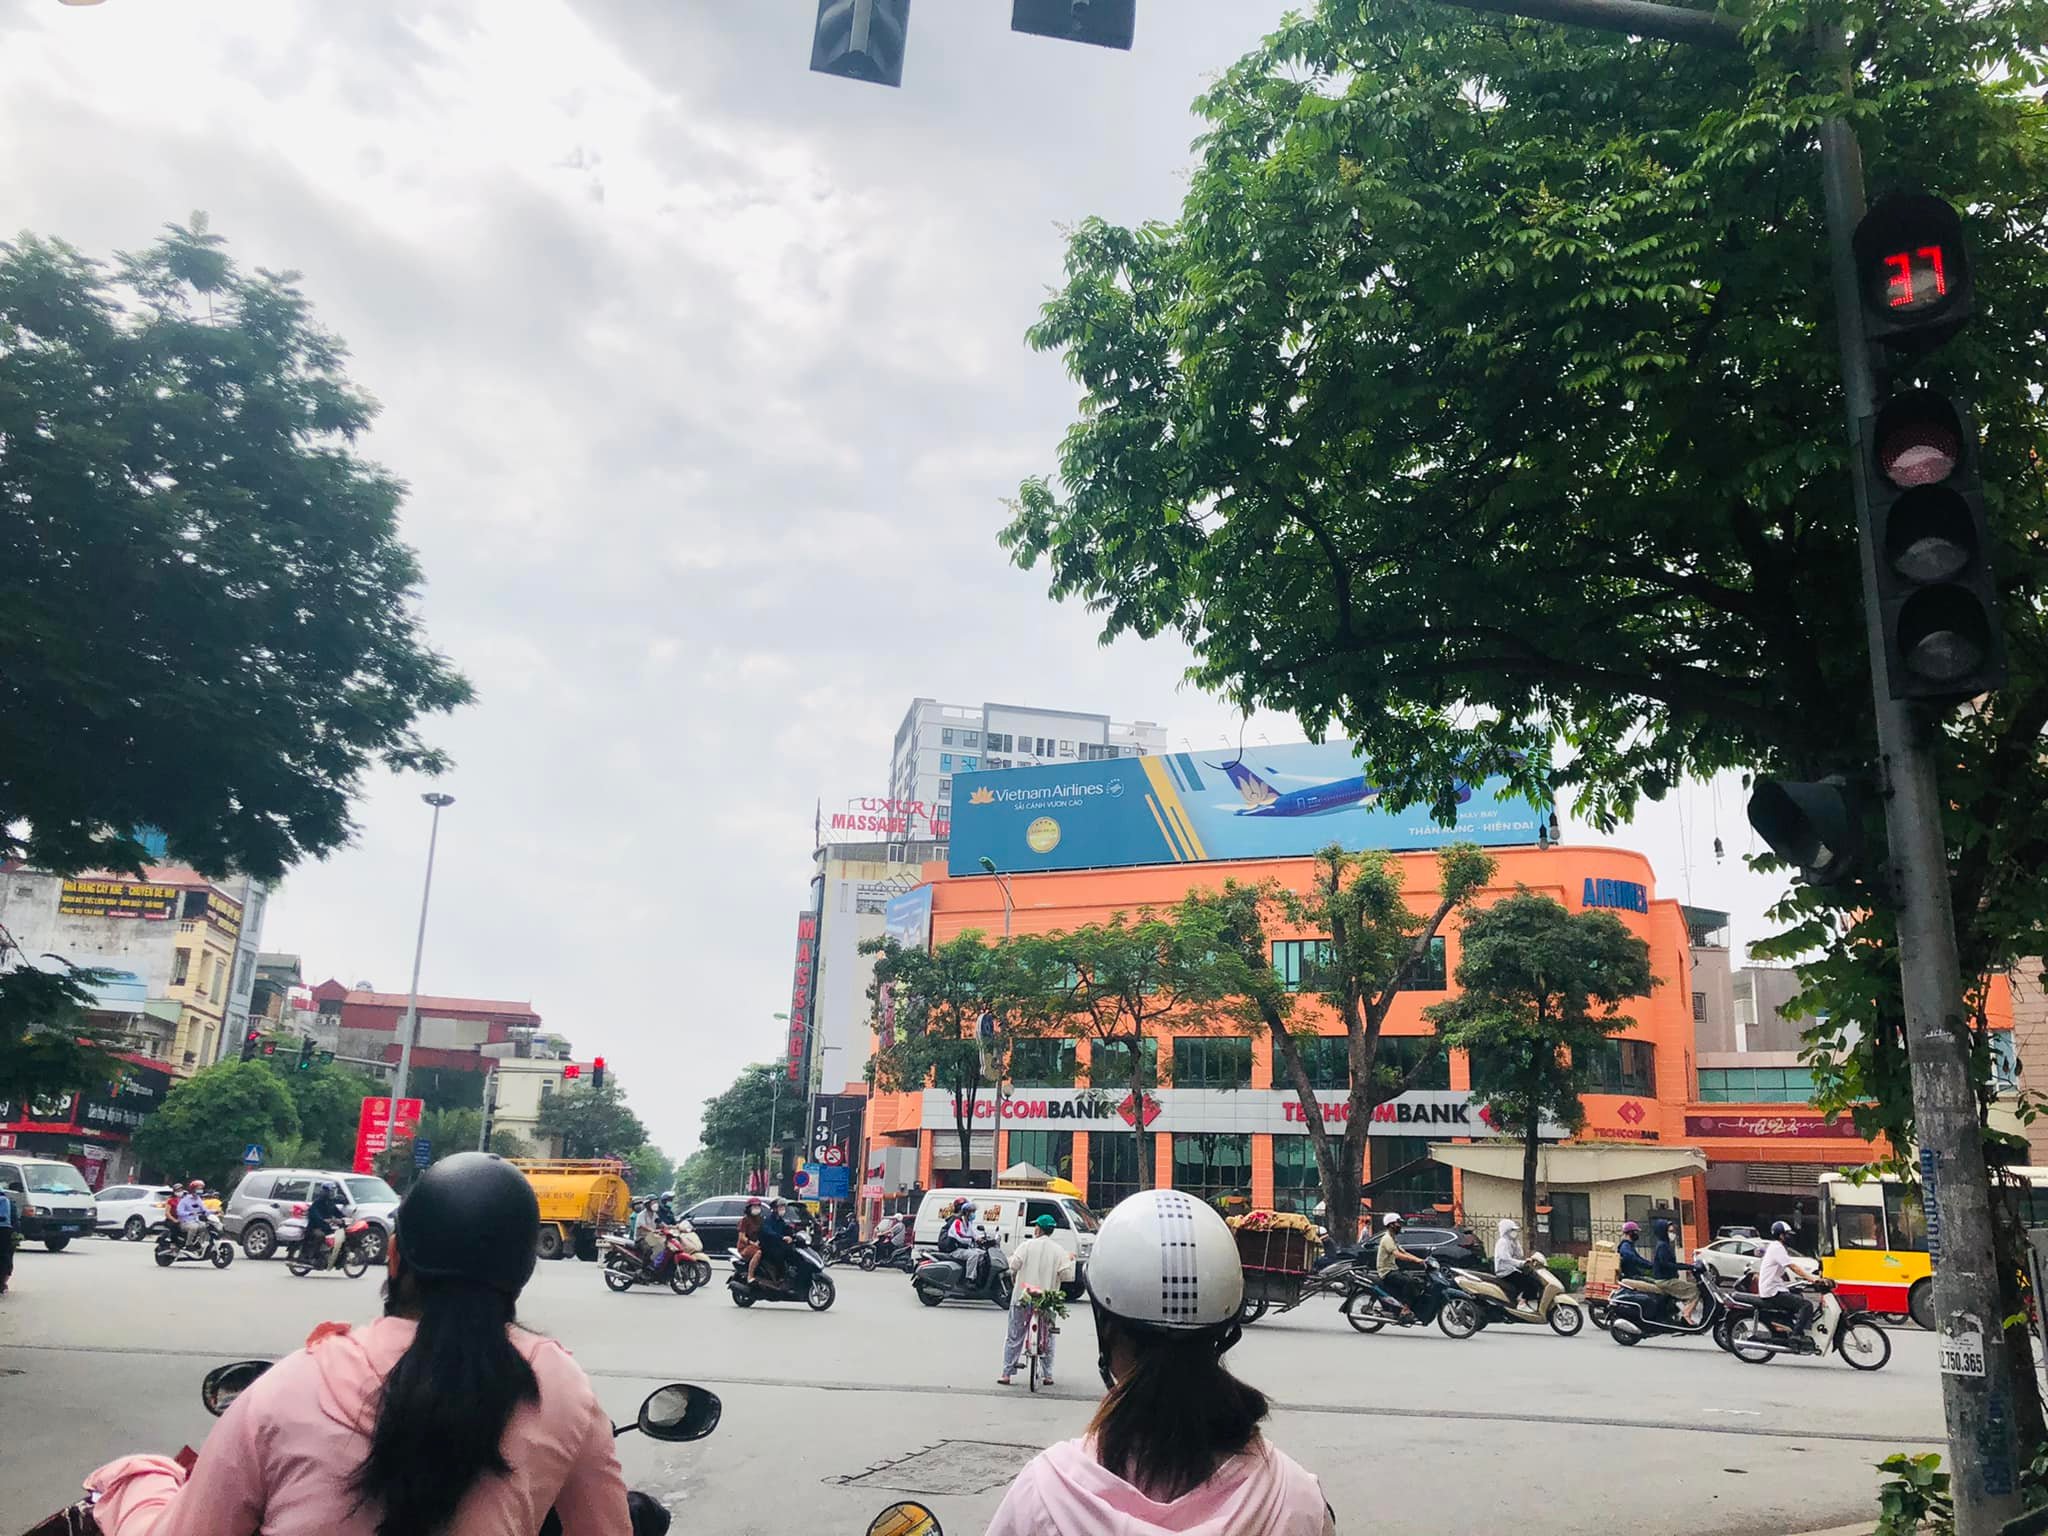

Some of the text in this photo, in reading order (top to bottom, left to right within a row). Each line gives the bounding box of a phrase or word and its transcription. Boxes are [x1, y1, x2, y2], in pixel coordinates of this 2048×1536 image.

[1884, 245, 1945, 307] 37
[996, 783, 1104, 802] Vietnam Airlines
[832, 814, 906, 833] MASSAGE
[788, 919, 816, 1081] MASSAGE
[1593, 1127, 1660, 1141] TECHCOMBANK
